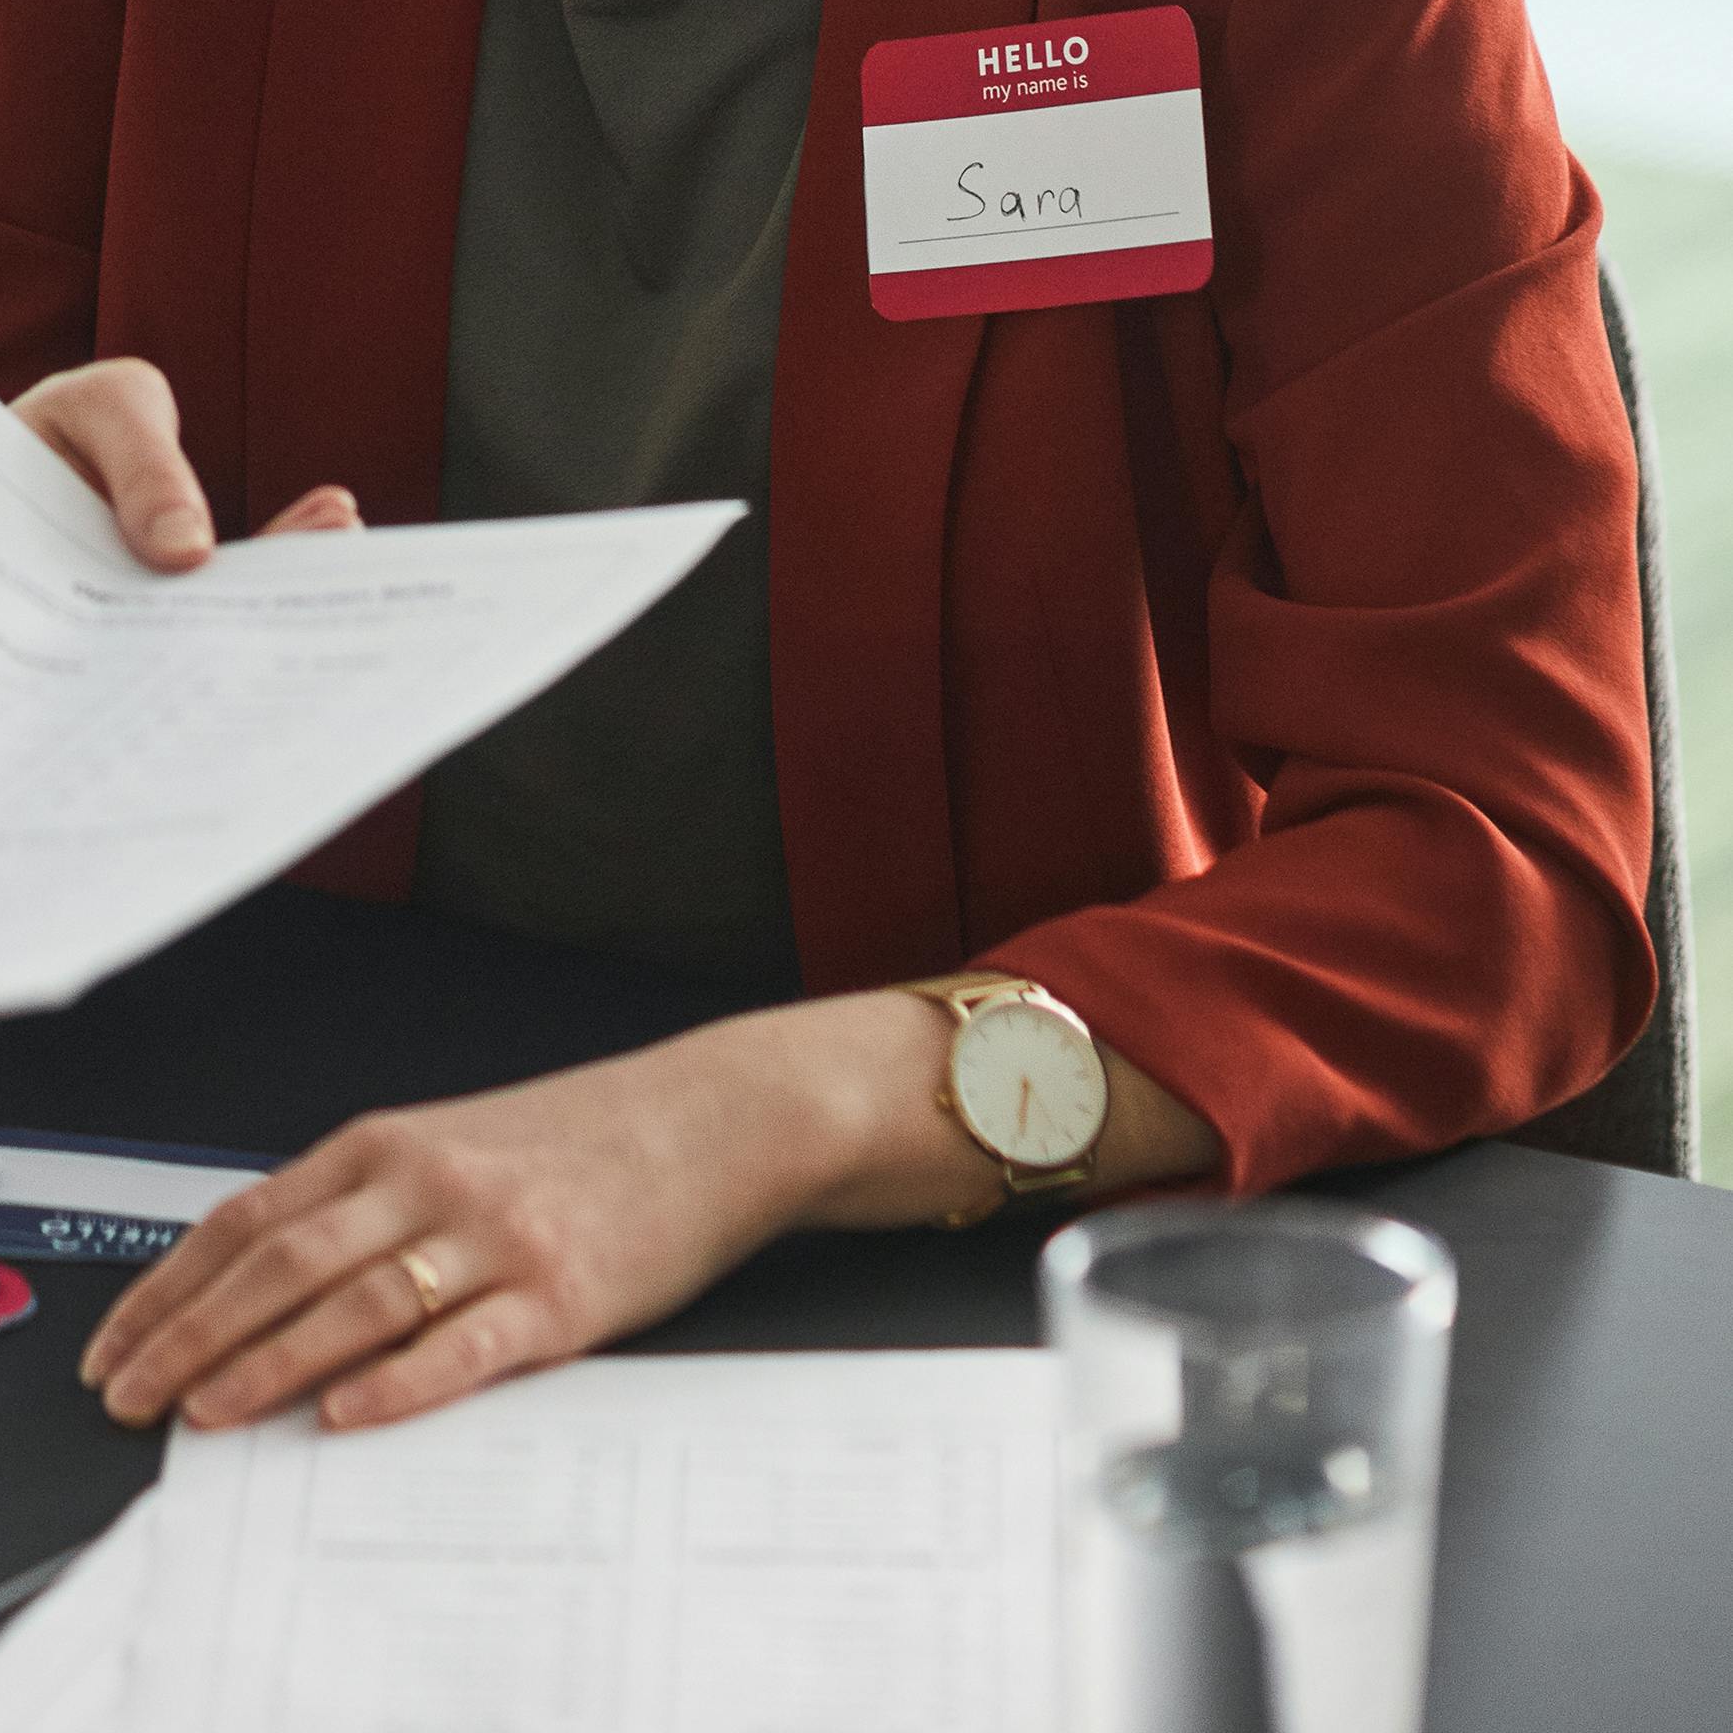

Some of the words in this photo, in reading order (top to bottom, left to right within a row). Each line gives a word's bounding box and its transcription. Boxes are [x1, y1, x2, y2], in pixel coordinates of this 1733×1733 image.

[978, 35, 1089, 76] HELLO
[982, 83, 1011, 103] my
[1017, 77, 1068, 96] name
[1073, 70, 1089, 89] is
[946, 161, 1084, 222] Sara
